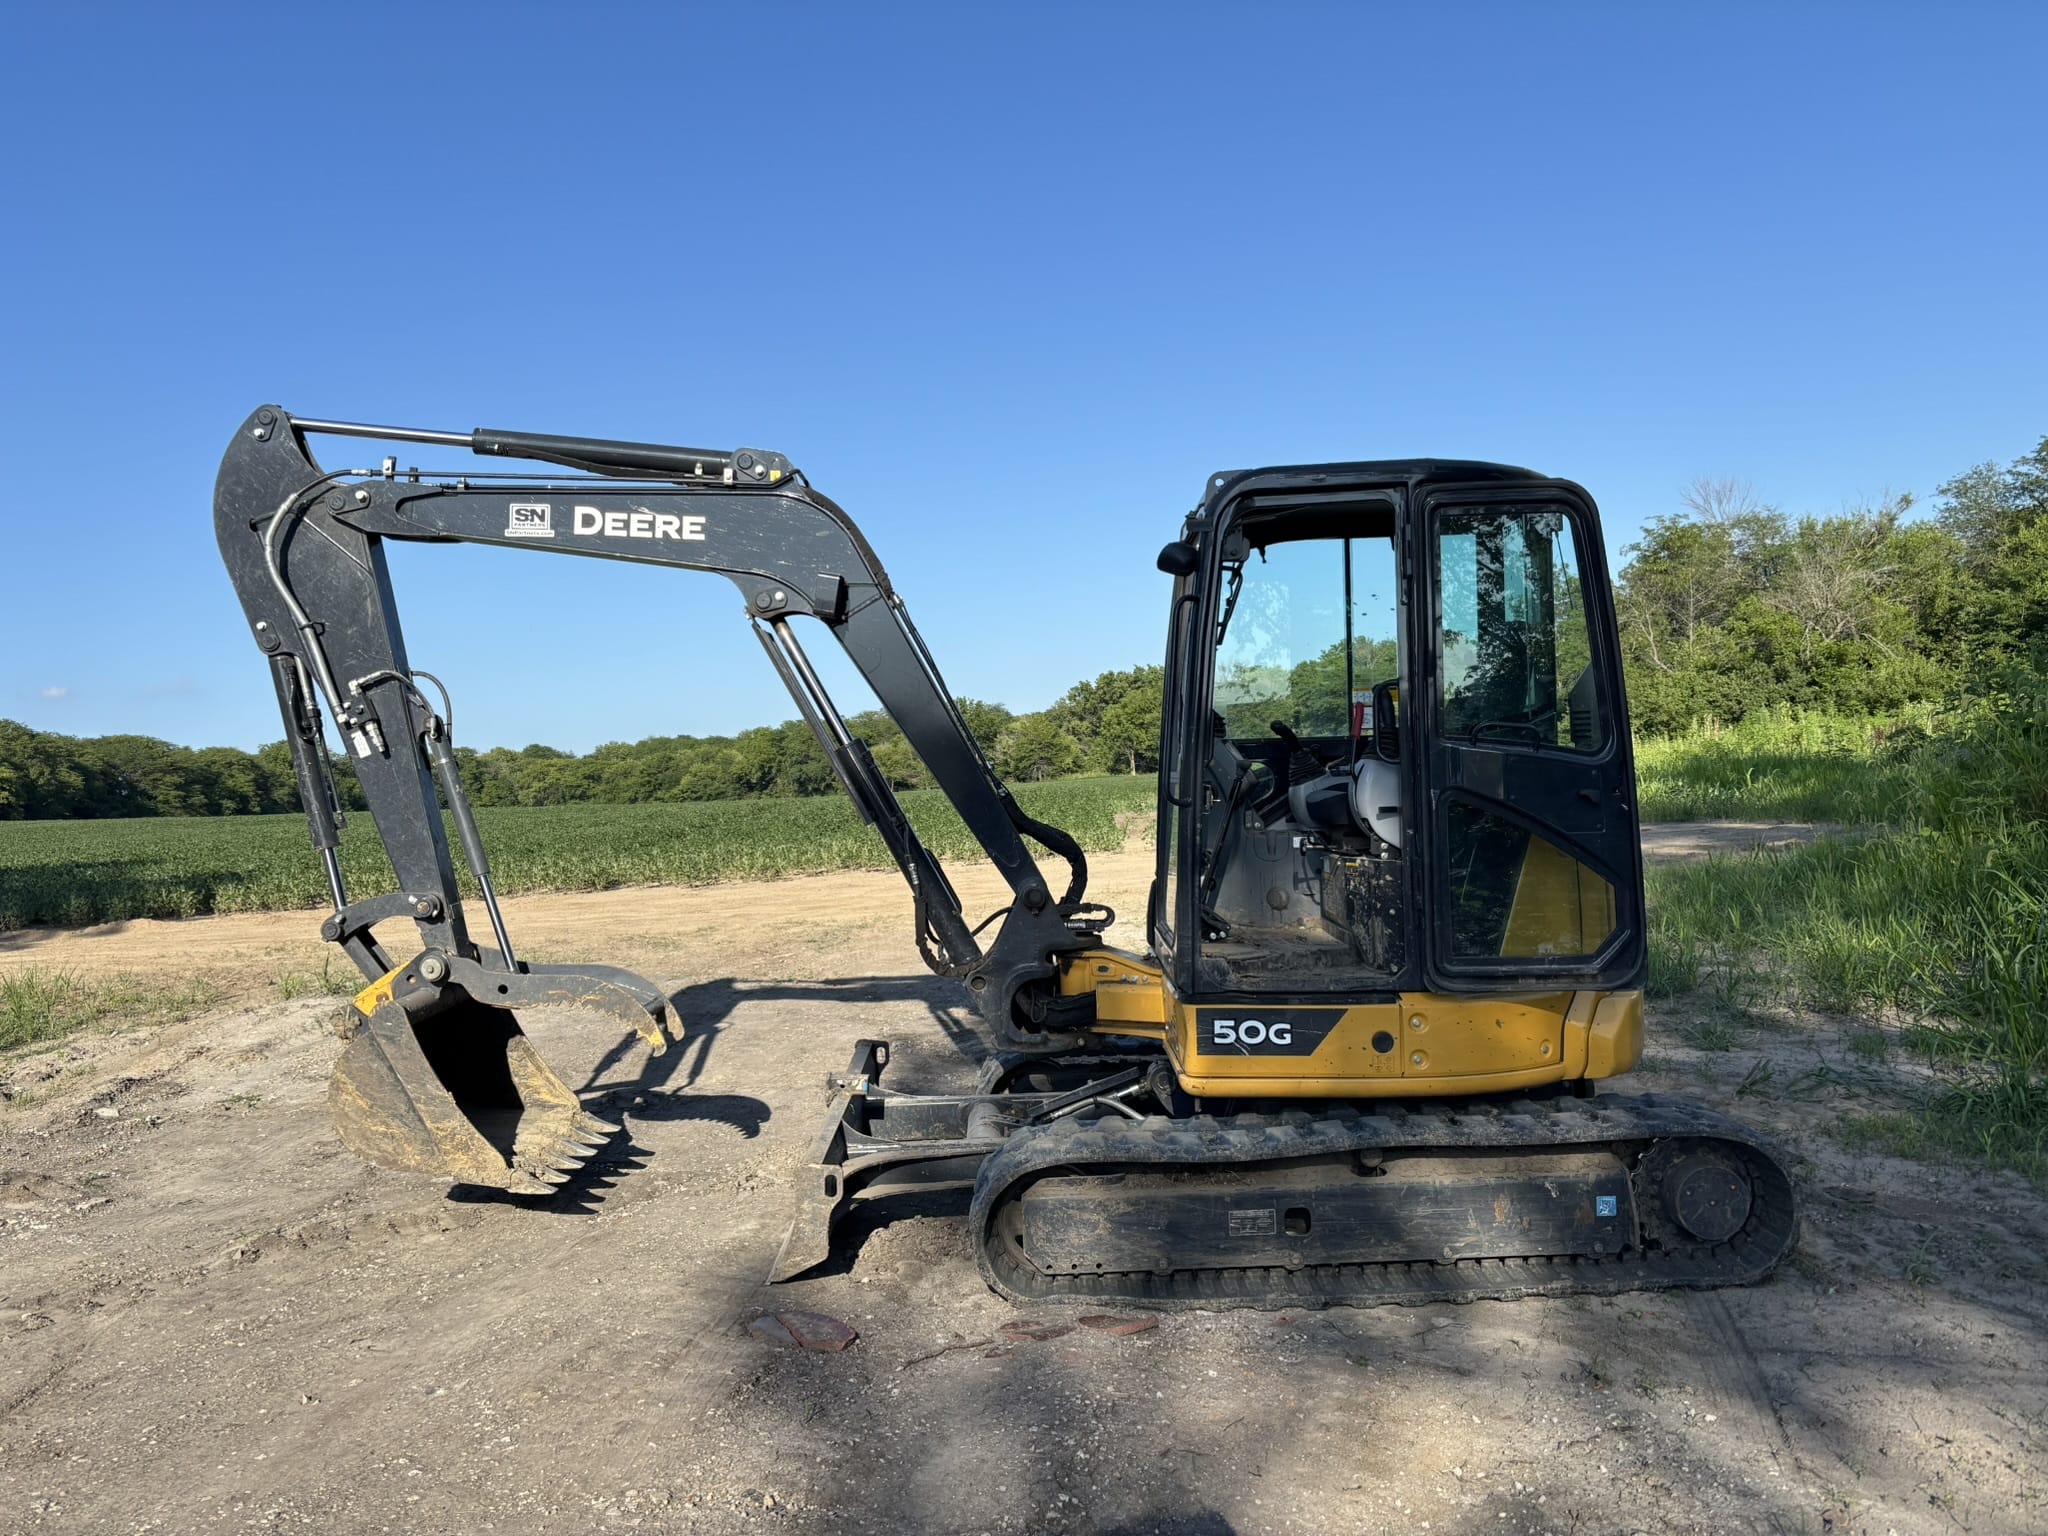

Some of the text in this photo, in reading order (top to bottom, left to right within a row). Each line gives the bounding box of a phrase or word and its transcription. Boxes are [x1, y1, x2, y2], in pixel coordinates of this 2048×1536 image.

[514, 508, 546, 522] SN
[573, 505, 707, 541] DEERE
[1213, 1020, 1292, 1045] 50G
